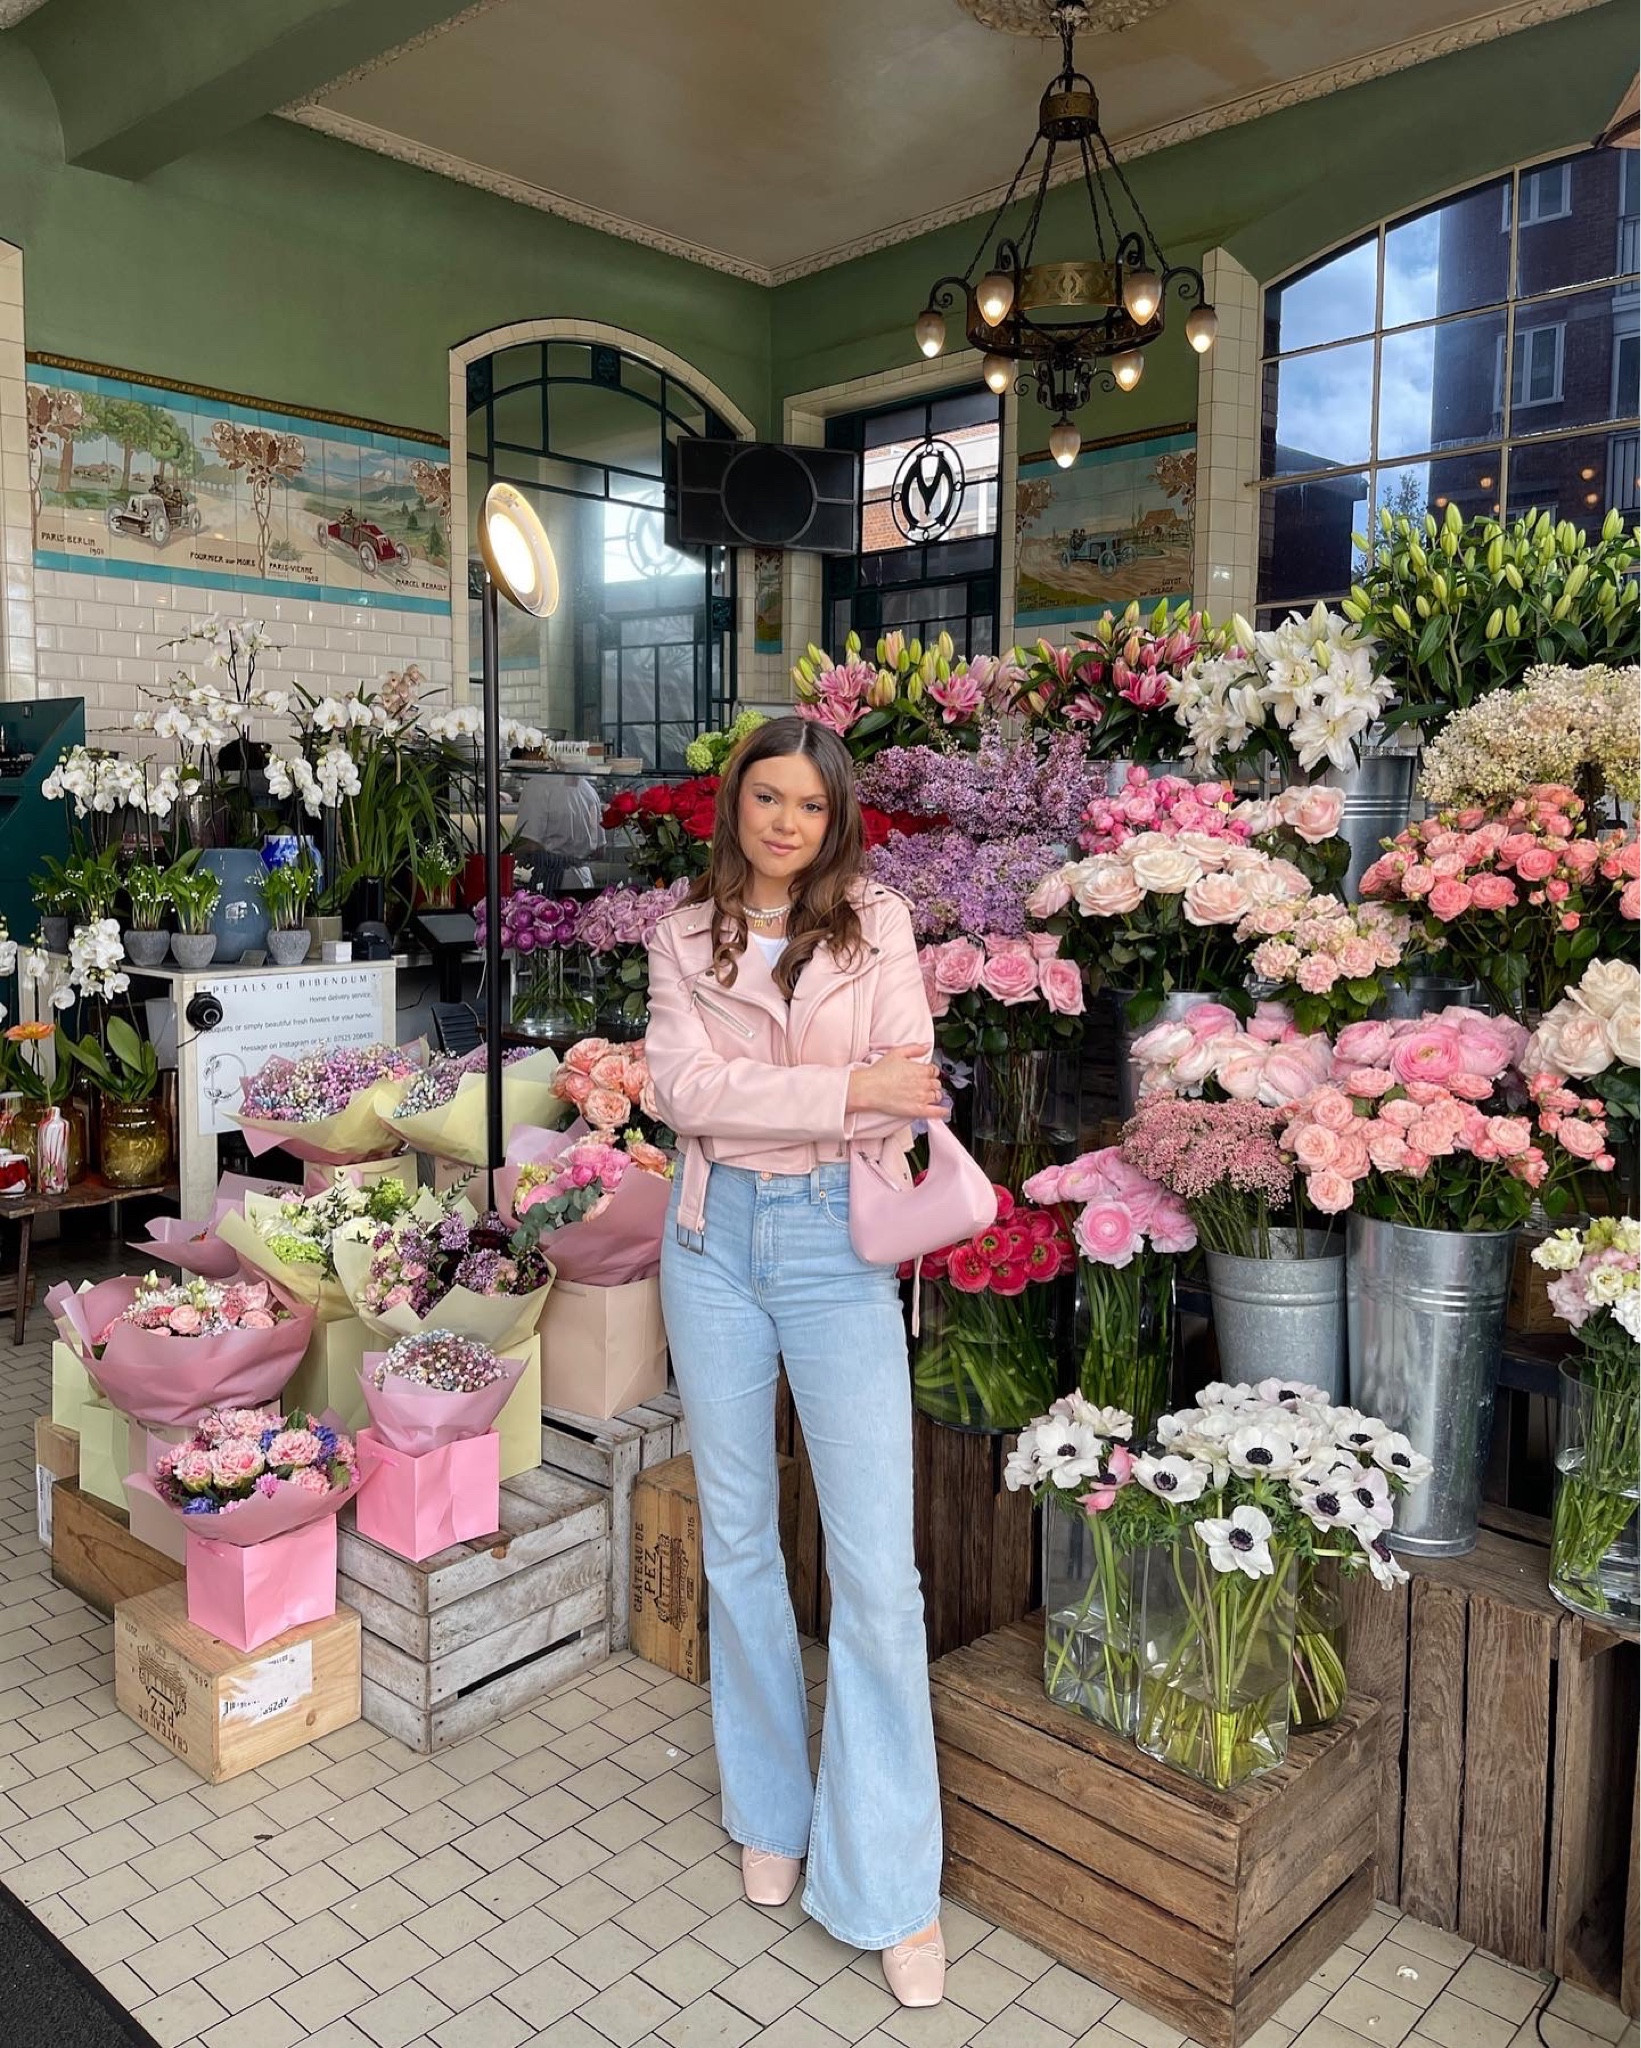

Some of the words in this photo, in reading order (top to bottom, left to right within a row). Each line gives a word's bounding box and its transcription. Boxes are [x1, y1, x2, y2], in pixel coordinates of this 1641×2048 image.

[41, 531, 95, 546] PARIS-BERLIN
[190, 551, 224, 563] FOURNIER
[269, 562, 313, 574] PARIS-VIENNE
[212, 982, 267, 994] PETALS
[276, 980, 290, 991] of
[299, 974, 368, 988] BIBENDUM
[309, 994, 327, 1002] Home
[327, 992, 350, 1002] delivery
[243, 1022, 264, 1031] simply
[265, 1020, 292, 1029] beautiful
[293, 1018, 308, 1026] fresh
[309, 1016, 330, 1024] flowers
[341, 1013, 355, 1022] your
[241, 1043, 267, 1053] Message
[278, 1039, 310, 1049] Instagram
[634, 1521, 644, 1542] DE
[644, 1550, 657, 1597] PEZ
[138, 1703, 149, 1723] DE
[150, 1694, 175, 1729] PEZ
